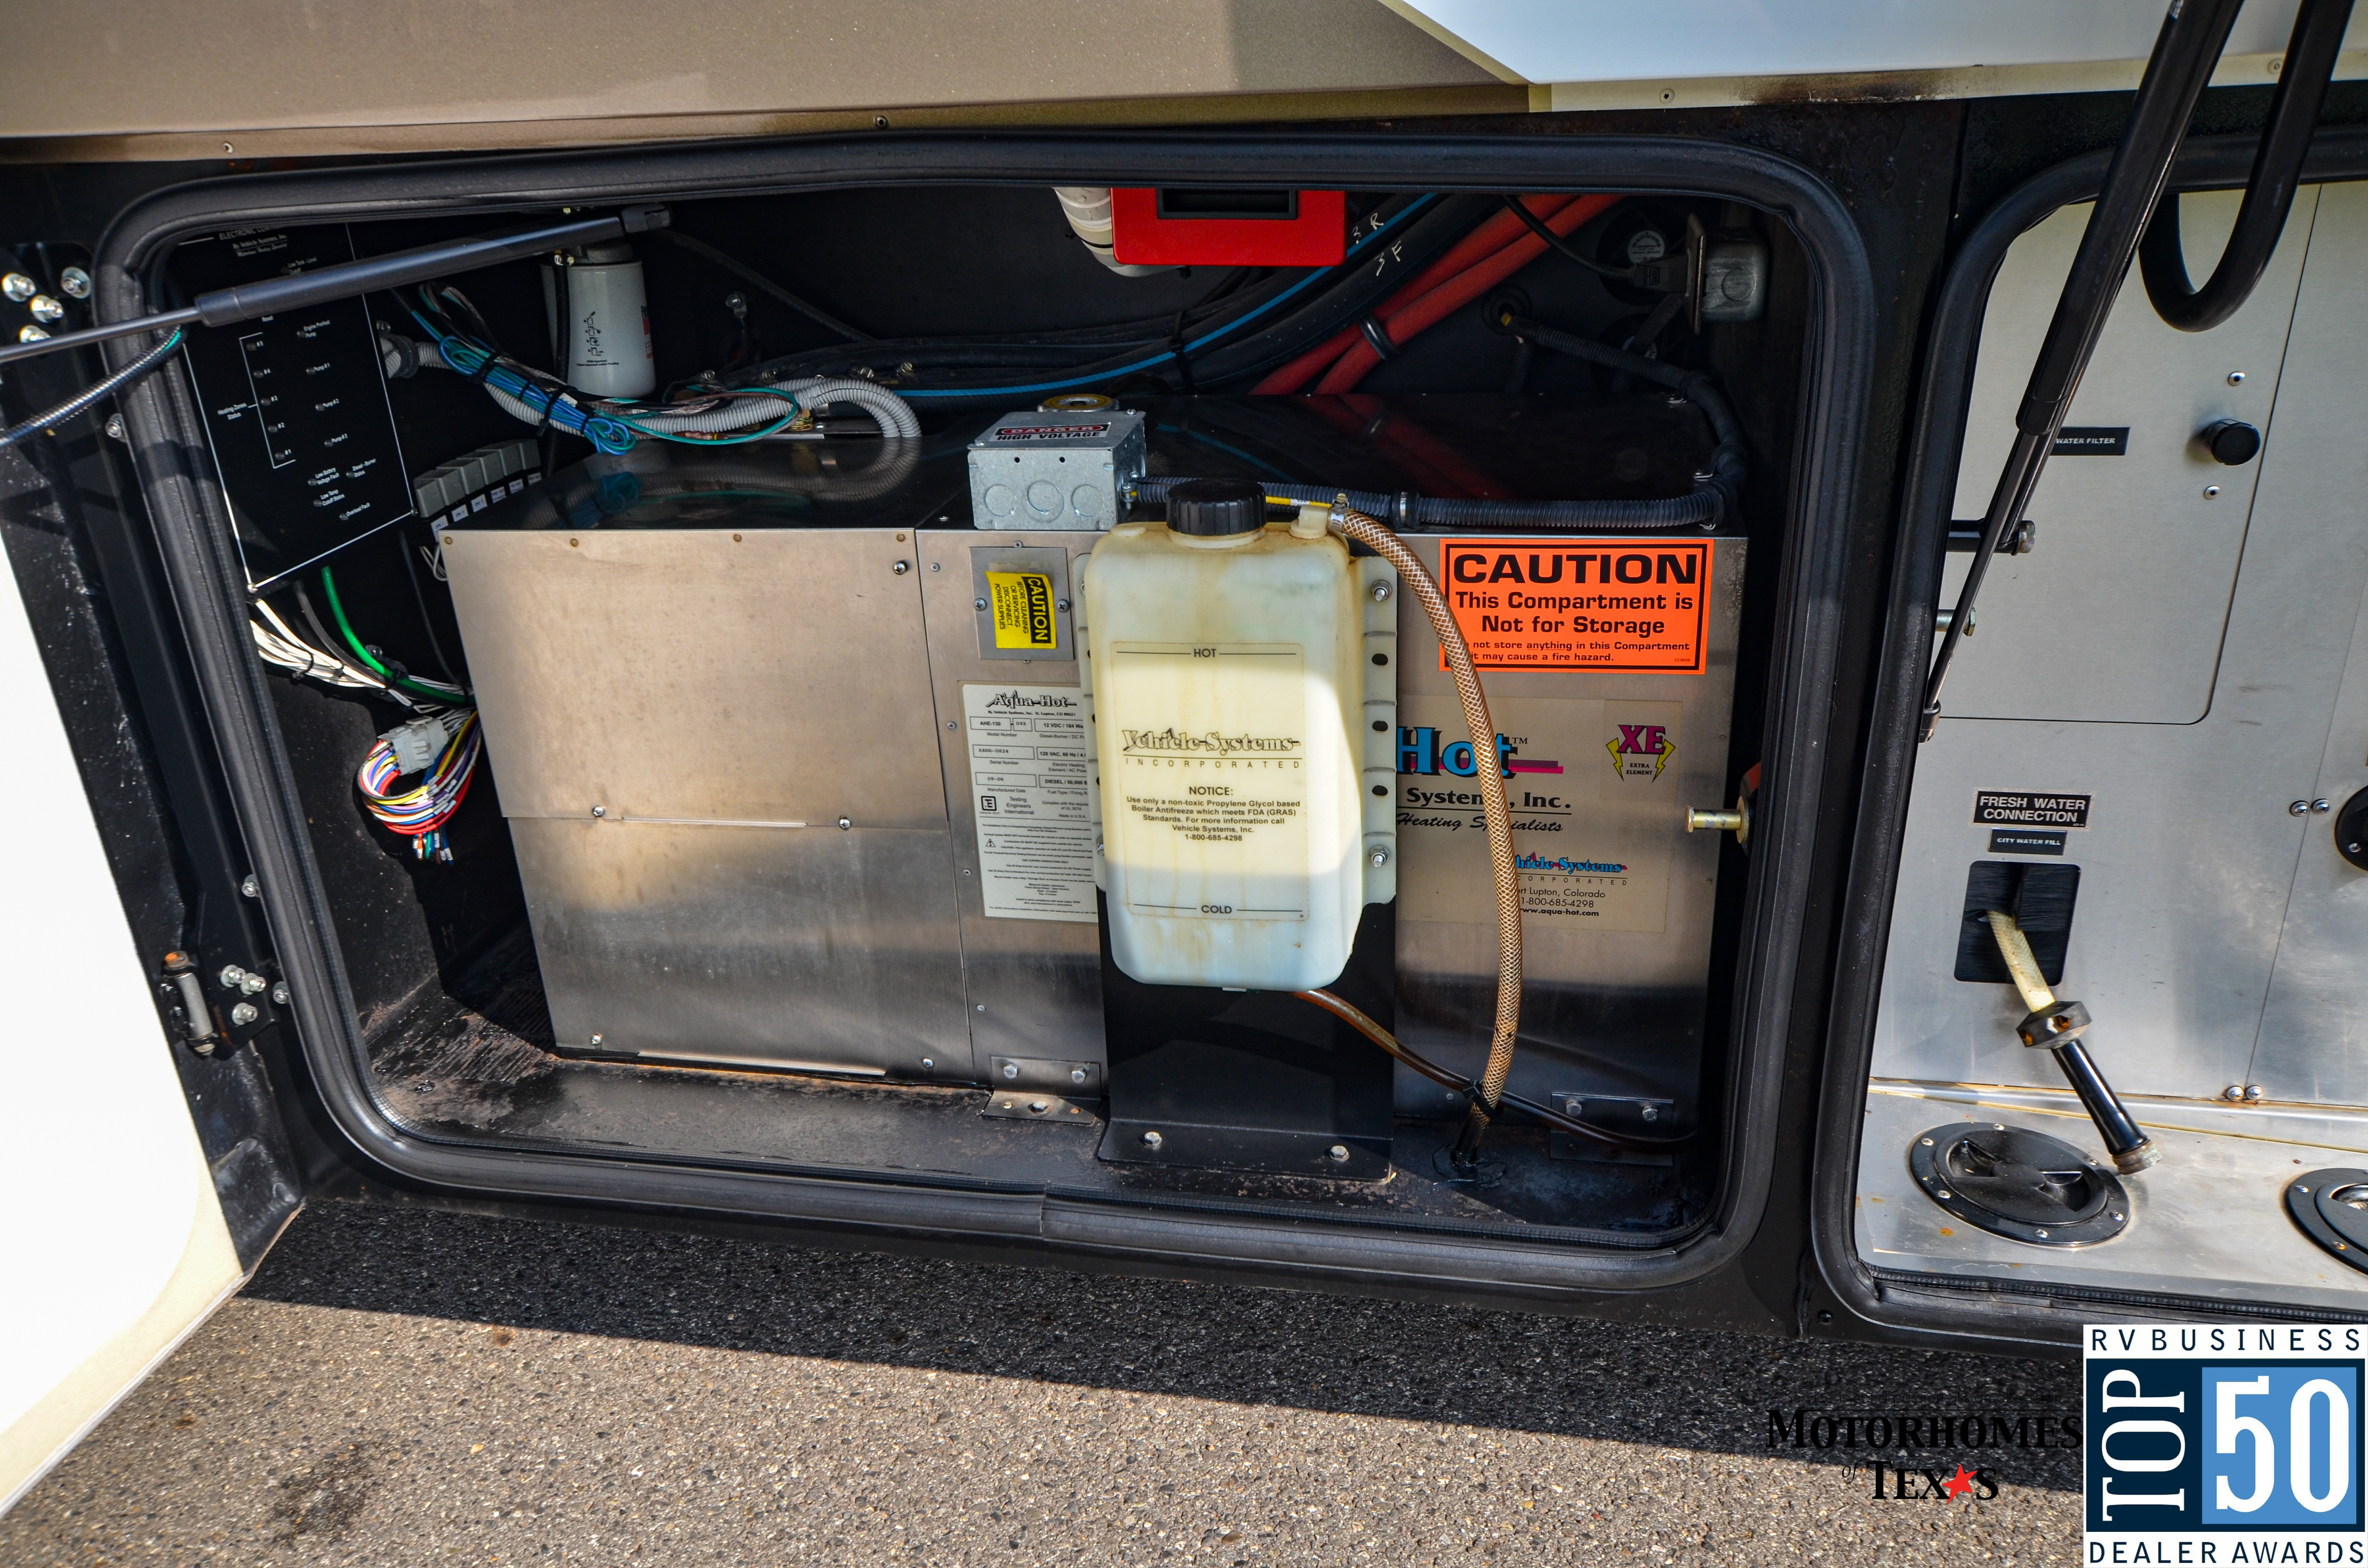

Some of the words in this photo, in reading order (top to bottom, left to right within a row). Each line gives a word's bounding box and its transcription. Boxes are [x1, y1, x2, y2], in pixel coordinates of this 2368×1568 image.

[1454, 554, 1697, 584] CAUTION
[994, 583, 1002, 604] POWER
[1017, 581, 1025, 600] BEFORE
[1003, 587, 1012, 625] DISCONNECT
[1012, 592, 1020, 627] SERVICING
[1027, 578, 1048, 640] CAUTION
[1455, 592, 1499, 609] This
[1508, 592, 1666, 613] Compartment
[1675, 593, 1692, 610] is
[1020, 601, 1028, 634] CLEANING
[1482, 615, 1523, 632] Not
[1532, 616, 1565, 633] for
[1573, 616, 1665, 638] Storage
[1194, 649, 1216, 659] HOT
[1527, 641, 1572, 651] anything
[1614, 642, 1689, 650] Compartment
[1482, 654, 1504, 662] may
[1574, 653, 1614, 662] hazard.
[986, 690, 1077, 709] Aqua-Hot
[1617, 724, 1666, 755] XE
[1126, 758, 1299, 769] INCORPORATED
[1189, 787, 1233, 796] NOTICE:
[1407, 787, 1515, 809] System,
[1524, 792, 1571, 808] Inc.
[1127, 796, 1140, 804] Use
[1143, 797, 1159, 806] only
[1168, 799, 1204, 807] non-toxic
[1207, 799, 1246, 808] Propylene
[1249, 800, 1274, 809] Glycol
[1155, 806, 1194, 815] Antifreeze
[1267, 808, 1295, 817] (GRAS)
[1980, 796, 2027, 808] FRESH
[2034, 798, 2086, 810] WATER
[1143, 815, 1183, 823] Standards.
[1396, 813, 1462, 831] Heating
[1984, 808, 2078, 822] CONNECTION
[1516, 856, 1554, 871] hicle
[1558, 857, 1623, 875] Systems
[1529, 887, 1560, 896] Lupton,
[1564, 889, 1605, 898] Colorado
[1202, 905, 1232, 914] COLD
[1521, 896, 1594, 908] 1-800-685-4298
